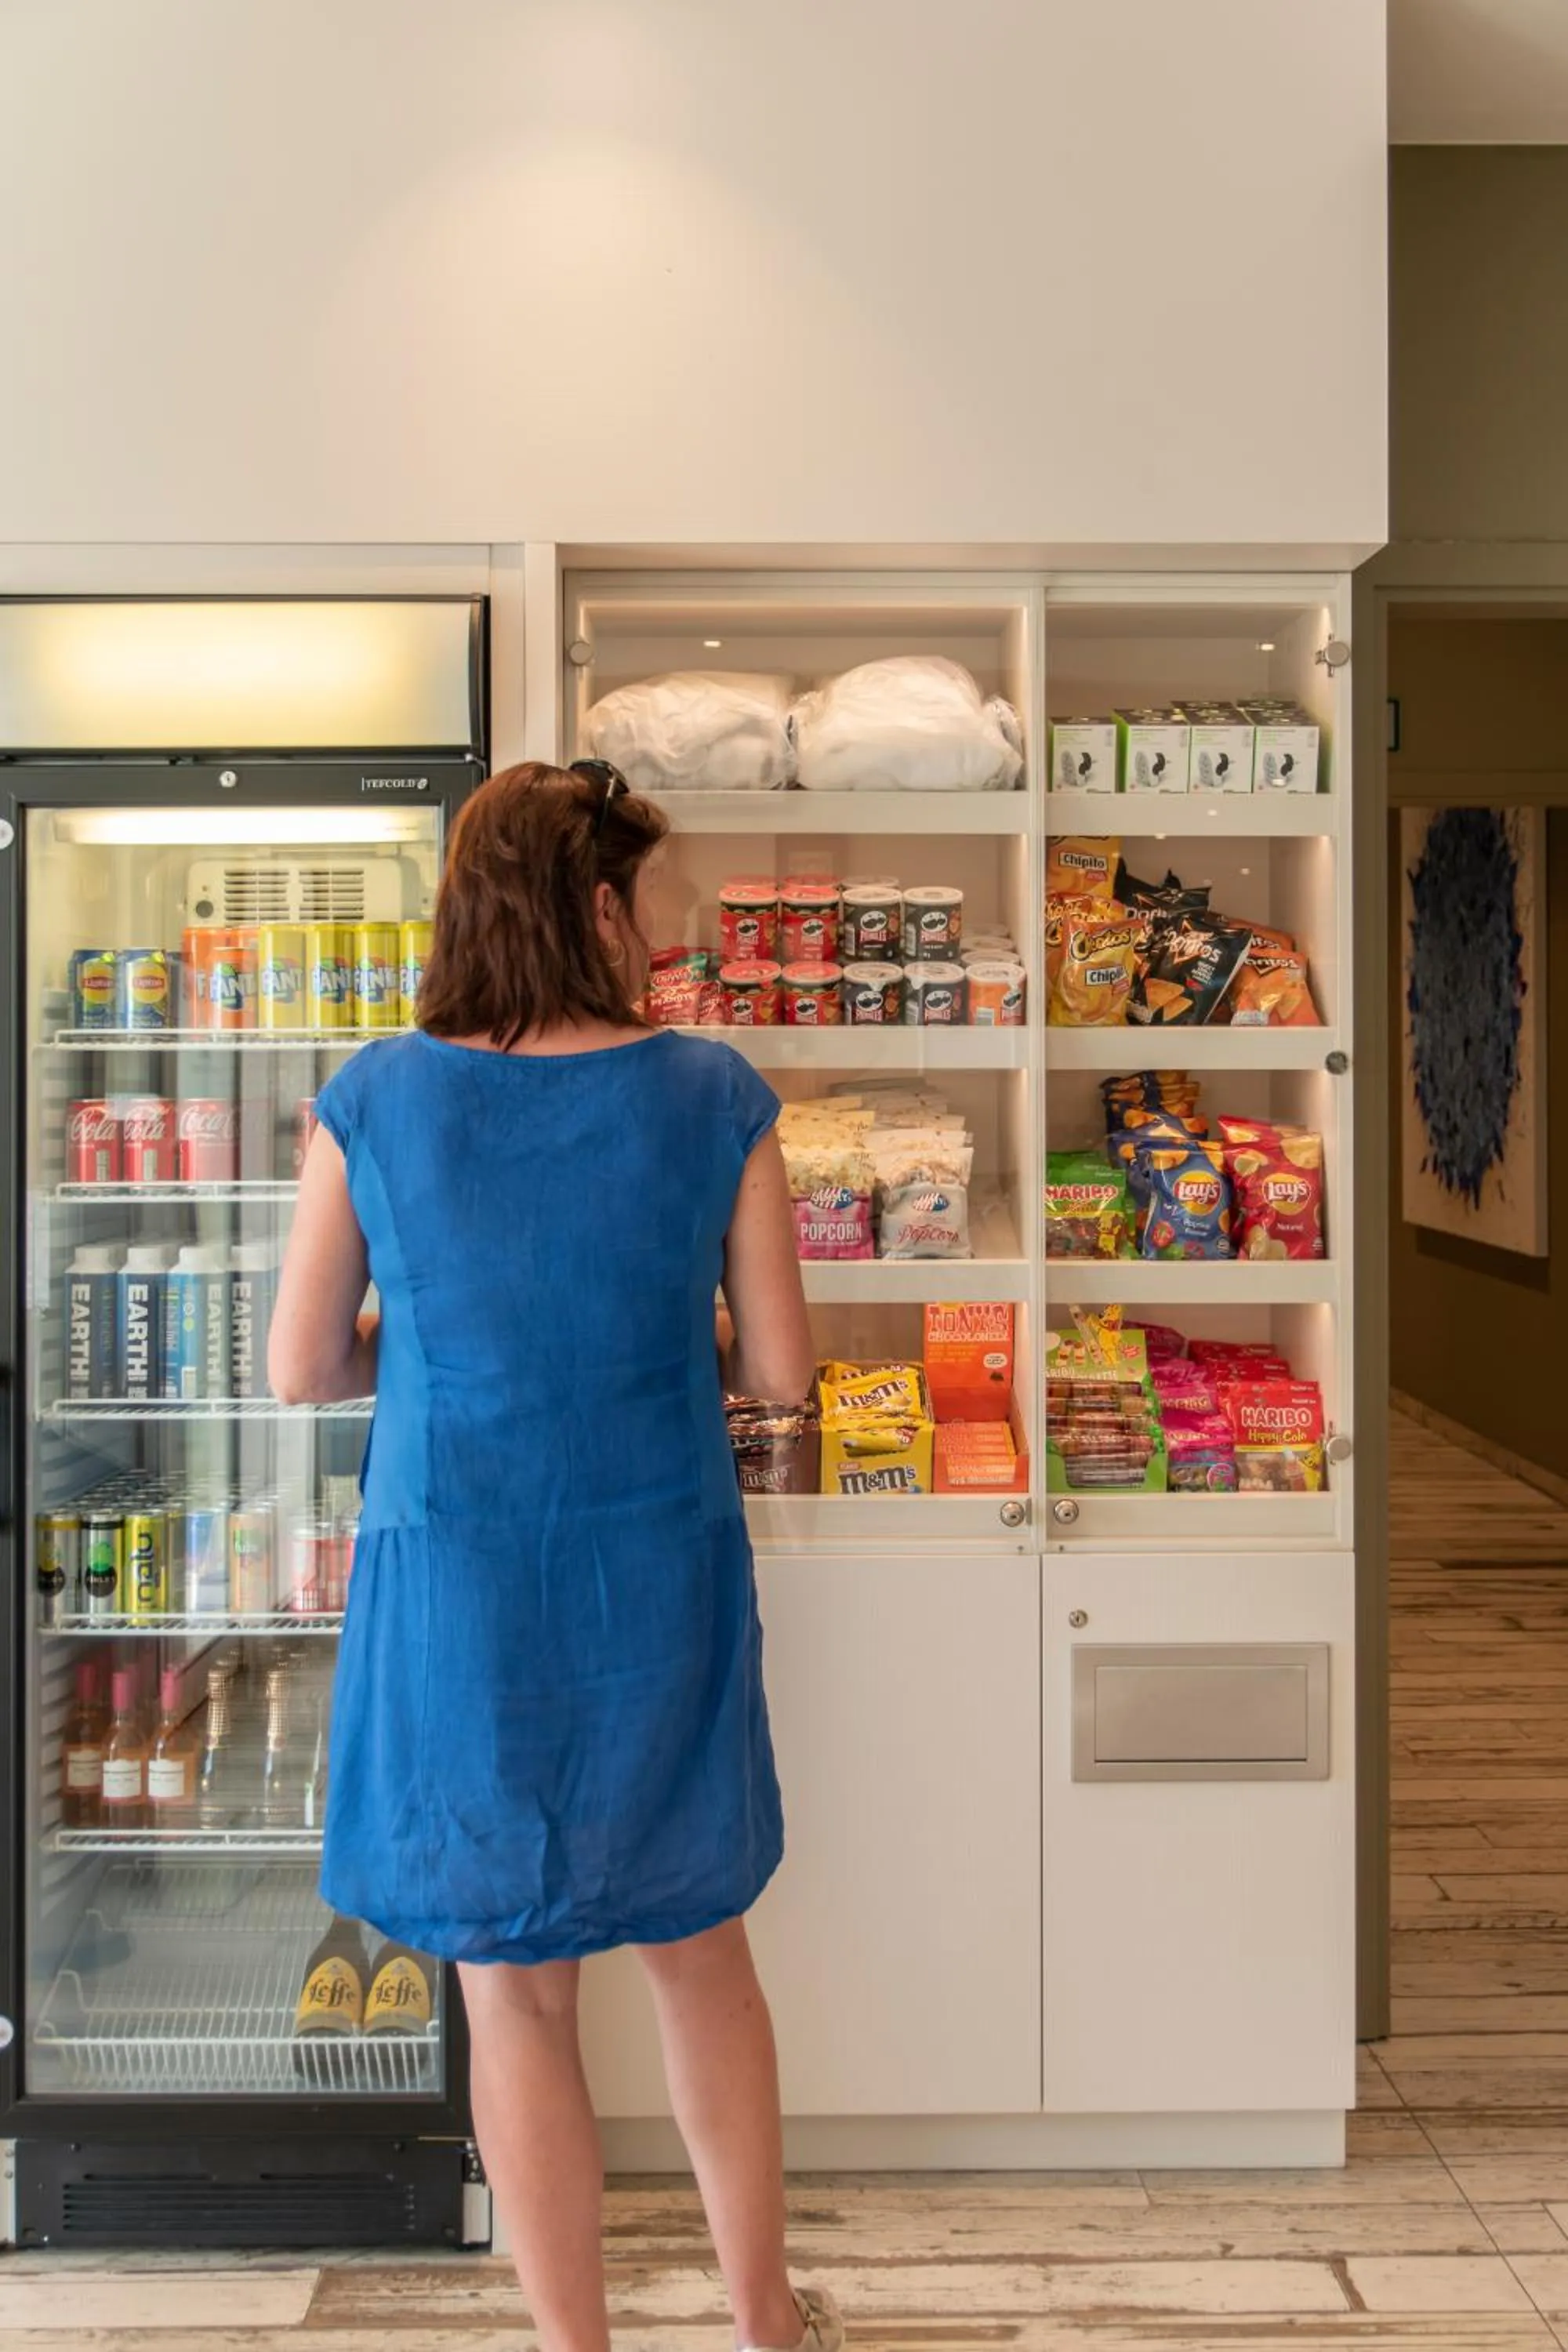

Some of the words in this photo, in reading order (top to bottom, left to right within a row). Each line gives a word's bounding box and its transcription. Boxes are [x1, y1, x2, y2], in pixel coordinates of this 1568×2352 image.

[366, 779, 416, 788] TEFCOLD
[800, 1222, 862, 1241] POPCORN
[898, 1224, 959, 1246] Popcorn
[71, 1283, 91, 1377] EARTH
[128, 1283, 149, 1377] EARTH
[208, 1283, 222, 1377] EARTH
[233, 1282, 252, 1374] EARTH
[1241, 1406, 1312, 1428] HARIBO
